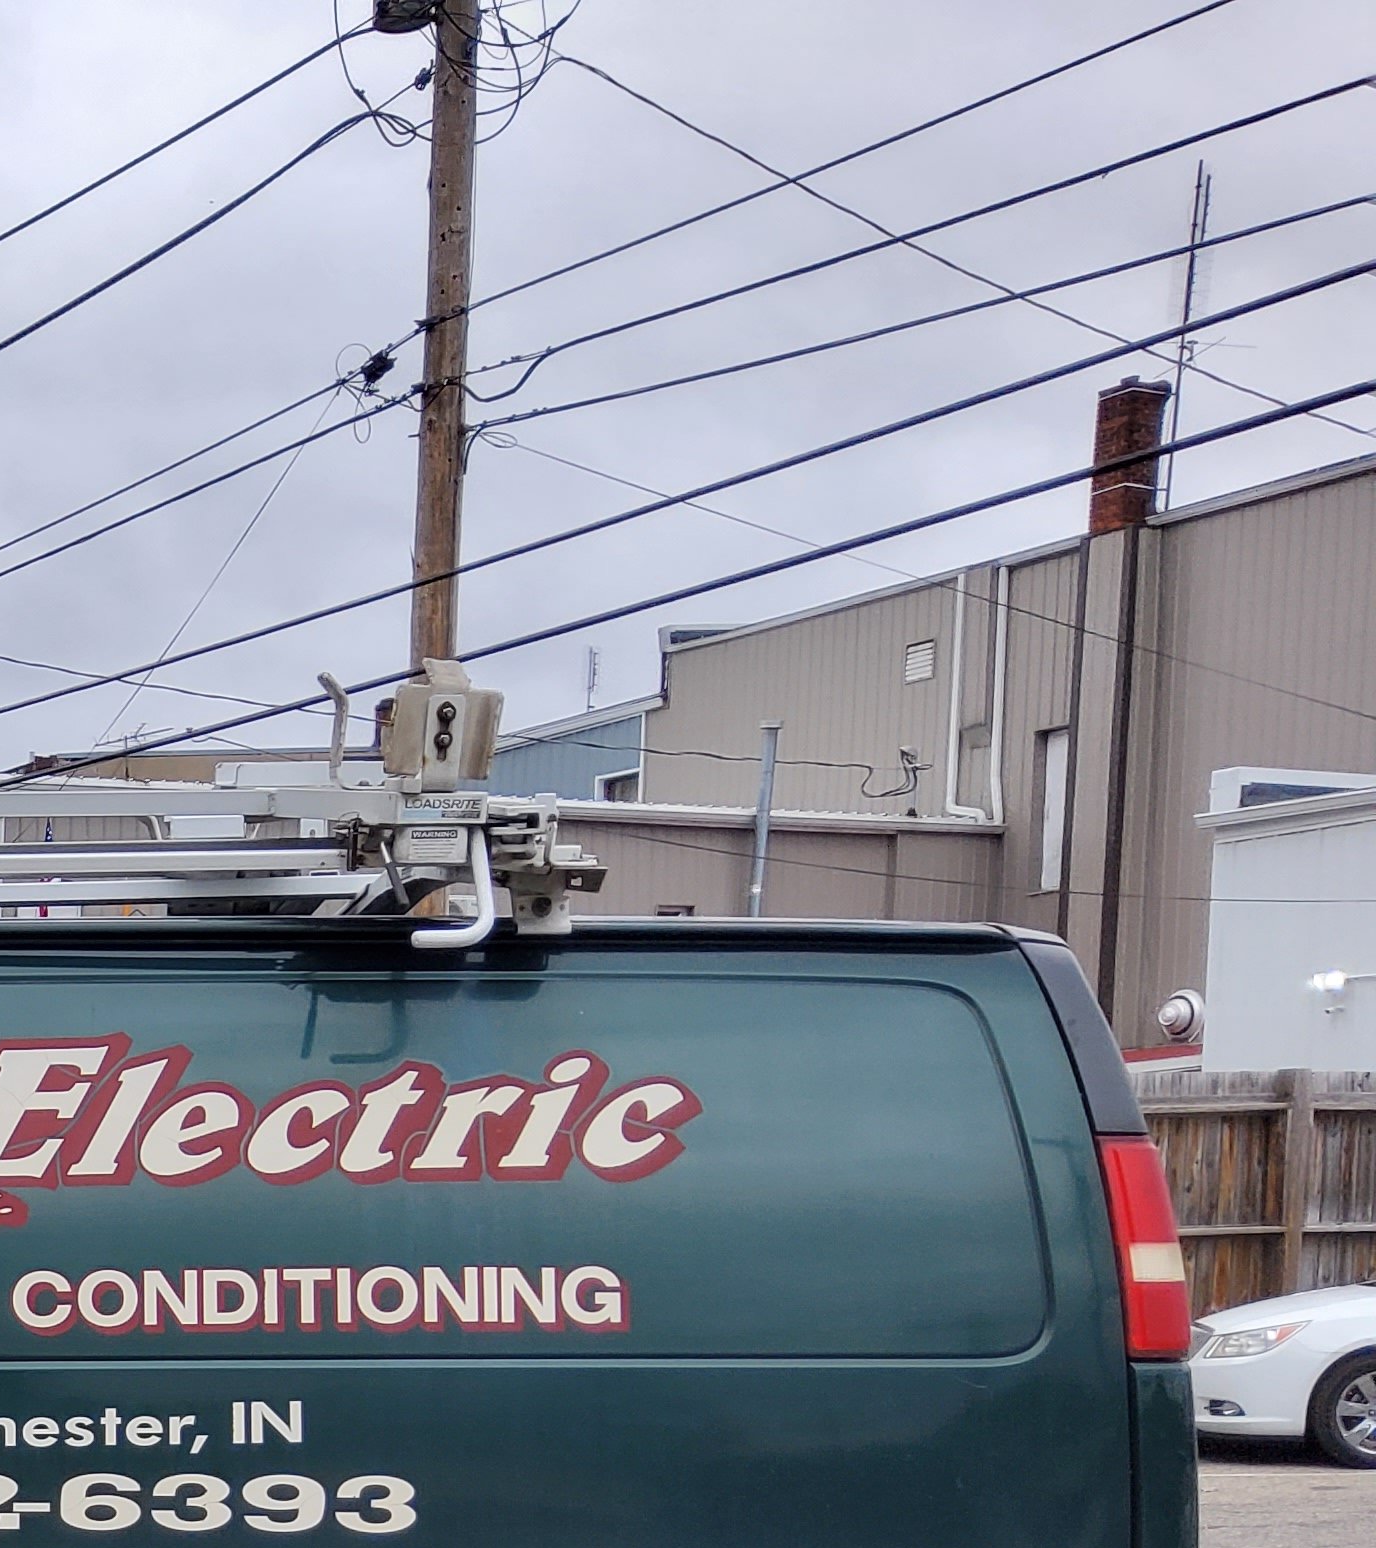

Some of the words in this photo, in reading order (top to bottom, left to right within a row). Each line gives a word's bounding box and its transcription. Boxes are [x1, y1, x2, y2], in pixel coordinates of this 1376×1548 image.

[404, 798, 483, 810] LOADSRITE
[11, 1265, 625, 1328] CONDITIONING
[232, 1400, 303, 1444] IN
